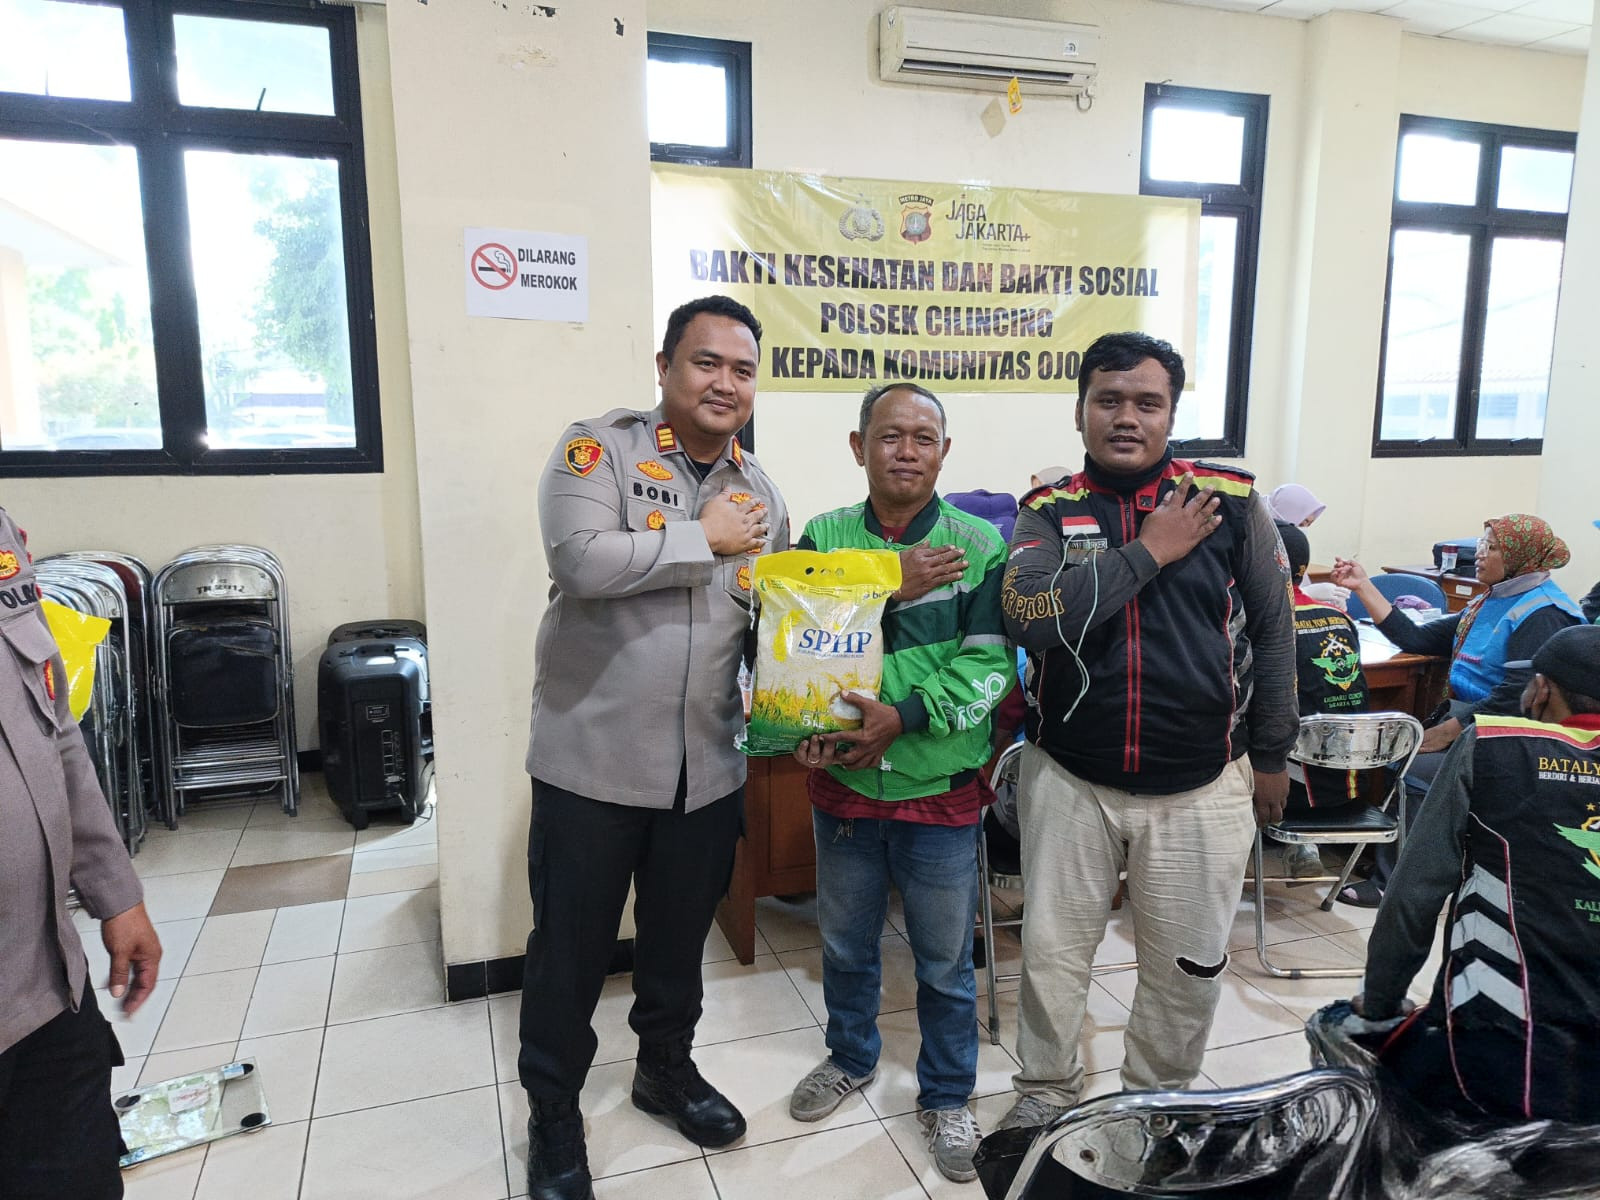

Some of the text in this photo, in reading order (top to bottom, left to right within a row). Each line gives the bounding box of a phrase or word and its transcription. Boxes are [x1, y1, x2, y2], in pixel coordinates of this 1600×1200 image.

[945, 199, 987, 222] JAGA
[518, 248, 576, 266] DILARANG
[520, 273, 578, 291] MEROKOK
[690, 249, 1159, 297] BAKTI KESEHATAN DAN BAKTI SOSIAL
[820, 302, 1054, 338] POLSEK CILINCING
[771, 346, 1086, 381] KEPADA KOMUNITAS OJO
[633, 482, 678, 507] BOBI
[798, 628, 872, 654] SPHP
[802, 715, 811, 727] 5
